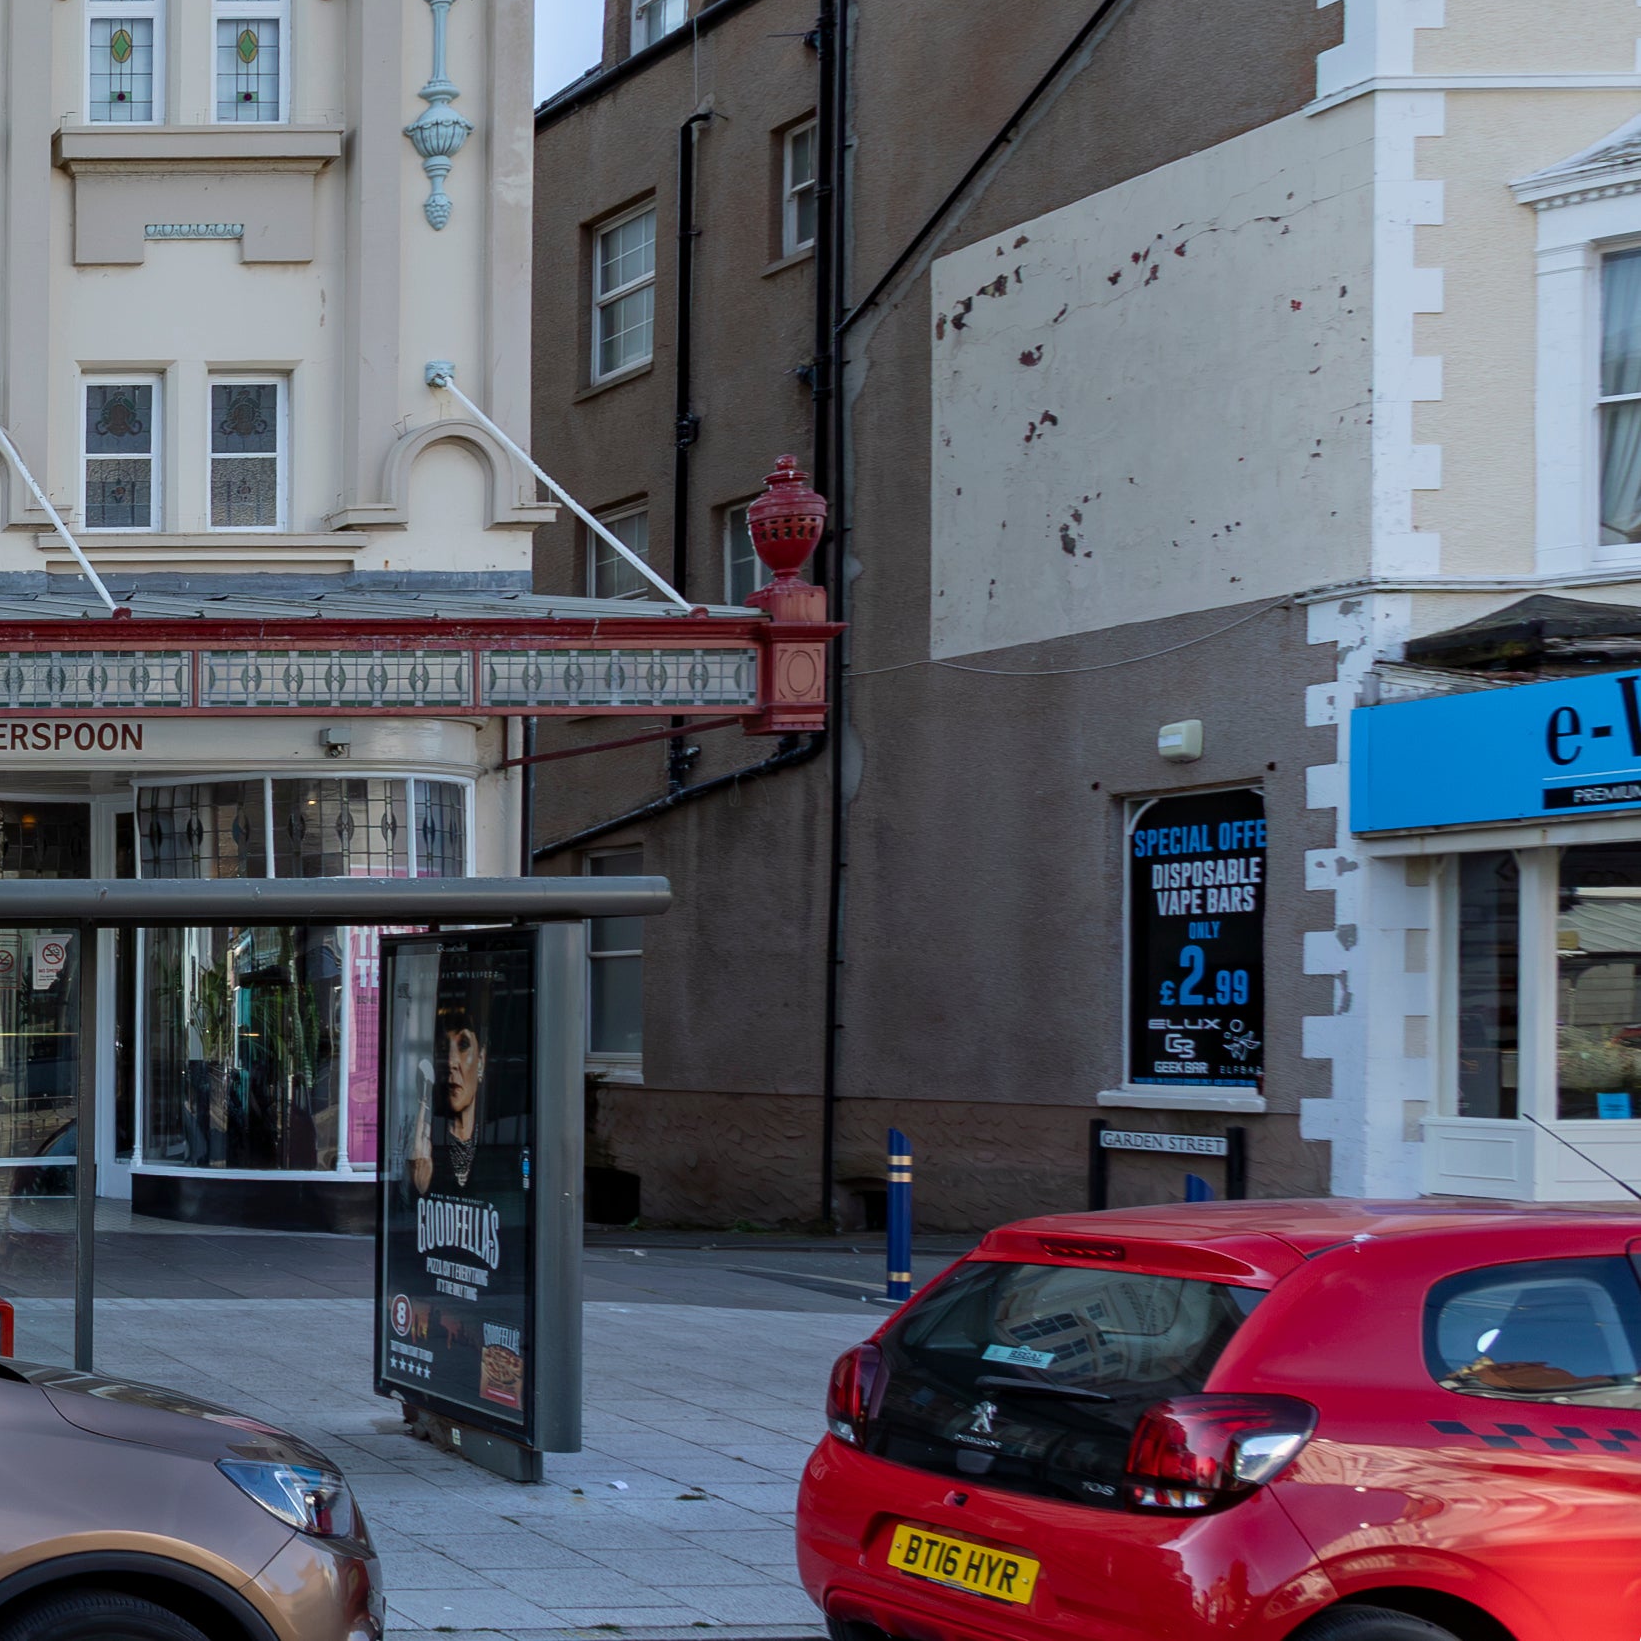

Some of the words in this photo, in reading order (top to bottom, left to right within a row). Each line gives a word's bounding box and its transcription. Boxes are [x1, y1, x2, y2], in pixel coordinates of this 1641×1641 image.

[1134, 825, 1214, 857] SPECIAL
[1152, 857, 1262, 889] DISPOSABLE
[1157, 889, 1202, 916] VAPE
[1206, 886, 1255, 913] BARS
[1188, 921, 1221, 939] ONLY
[1159, 944, 1249, 1006] £2.99
[1148, 1018, 1222, 1029] ELUX
[1154, 1061, 1183, 1073] GEEK
[1184, 1062, 1209, 1073] BAR
[1102, 1132, 1164, 1148] GARDEN
[1168, 1136, 1224, 1153] STREET
[417, 1197, 500, 1270] GOODFELLA'S
[903, 1533, 962, 1576] BT16
[963, 1550, 1019, 1594] HYR
